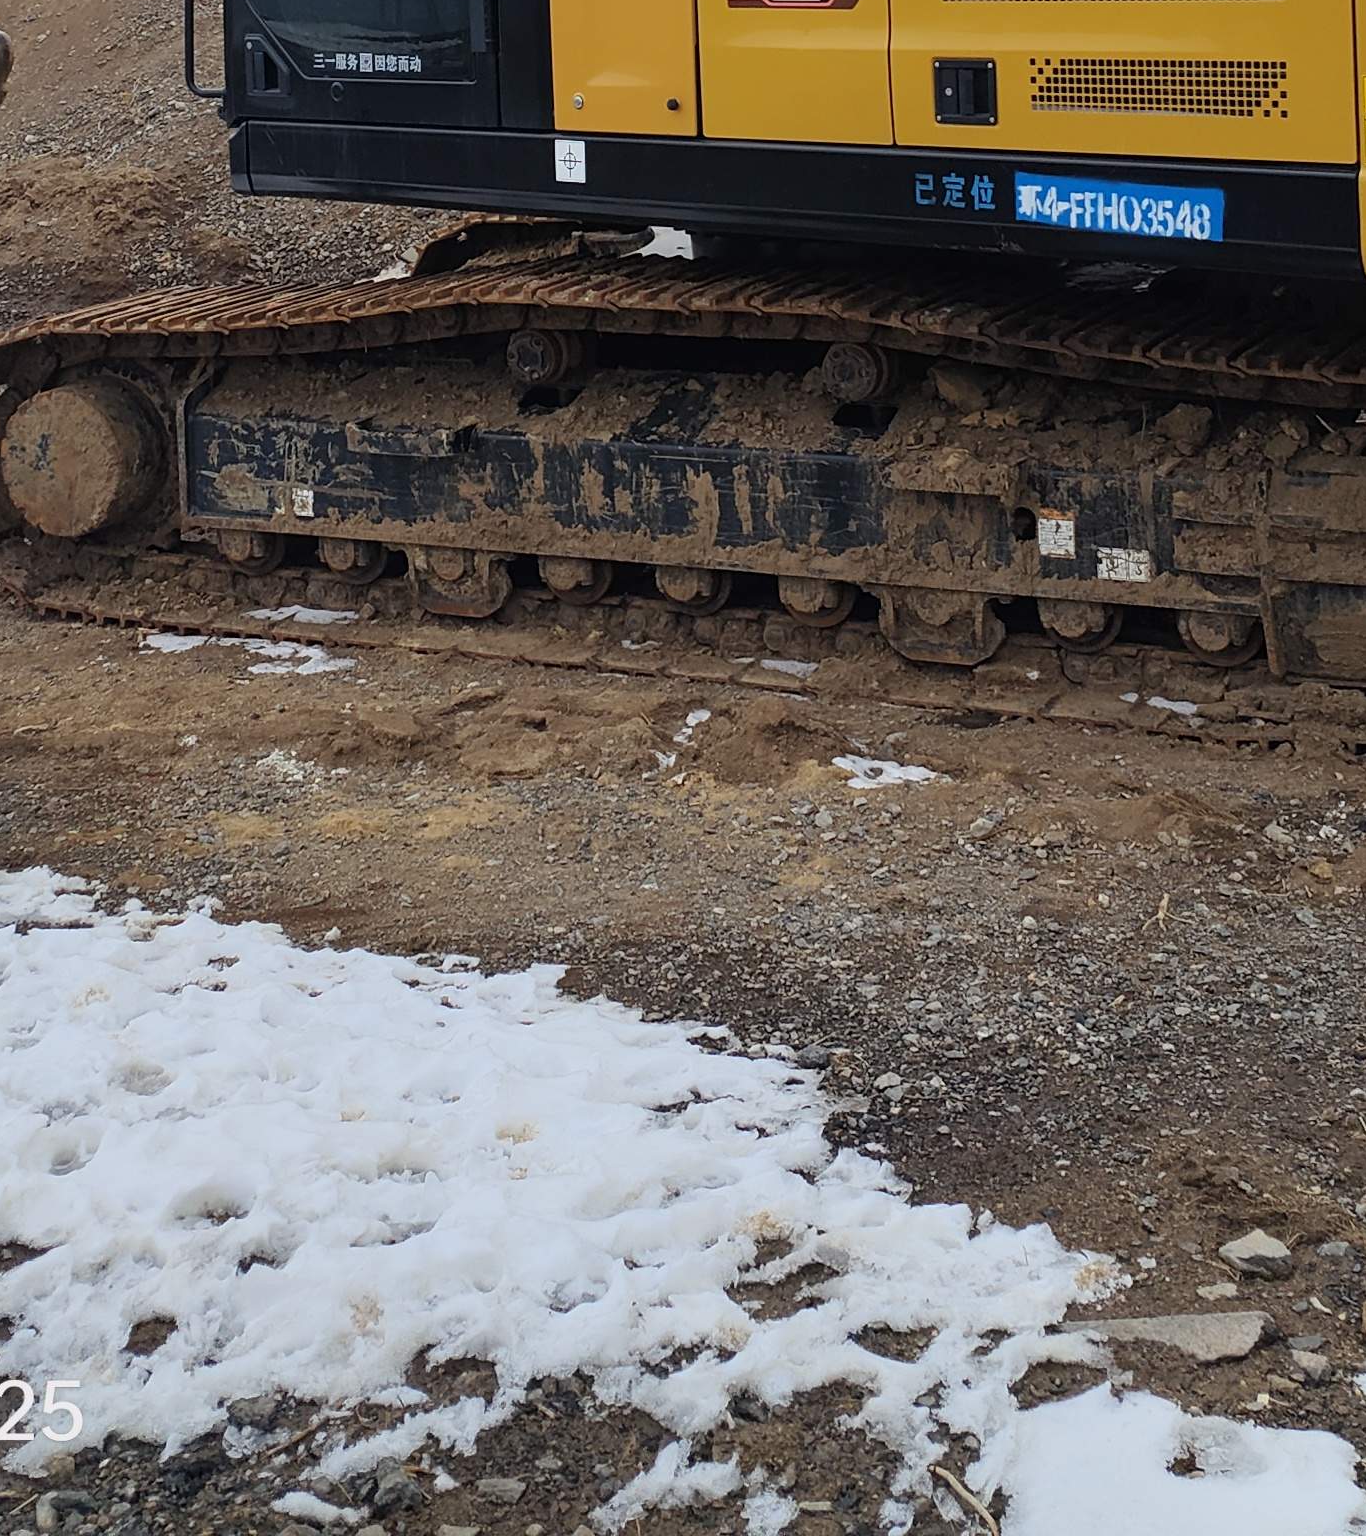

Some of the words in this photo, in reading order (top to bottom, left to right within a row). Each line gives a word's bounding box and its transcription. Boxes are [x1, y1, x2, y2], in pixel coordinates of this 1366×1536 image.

[313, 53, 358, 70] 三一服务
[374, 54, 422, 72] 因您而动
[914, 172, 996, 210] 已定位
